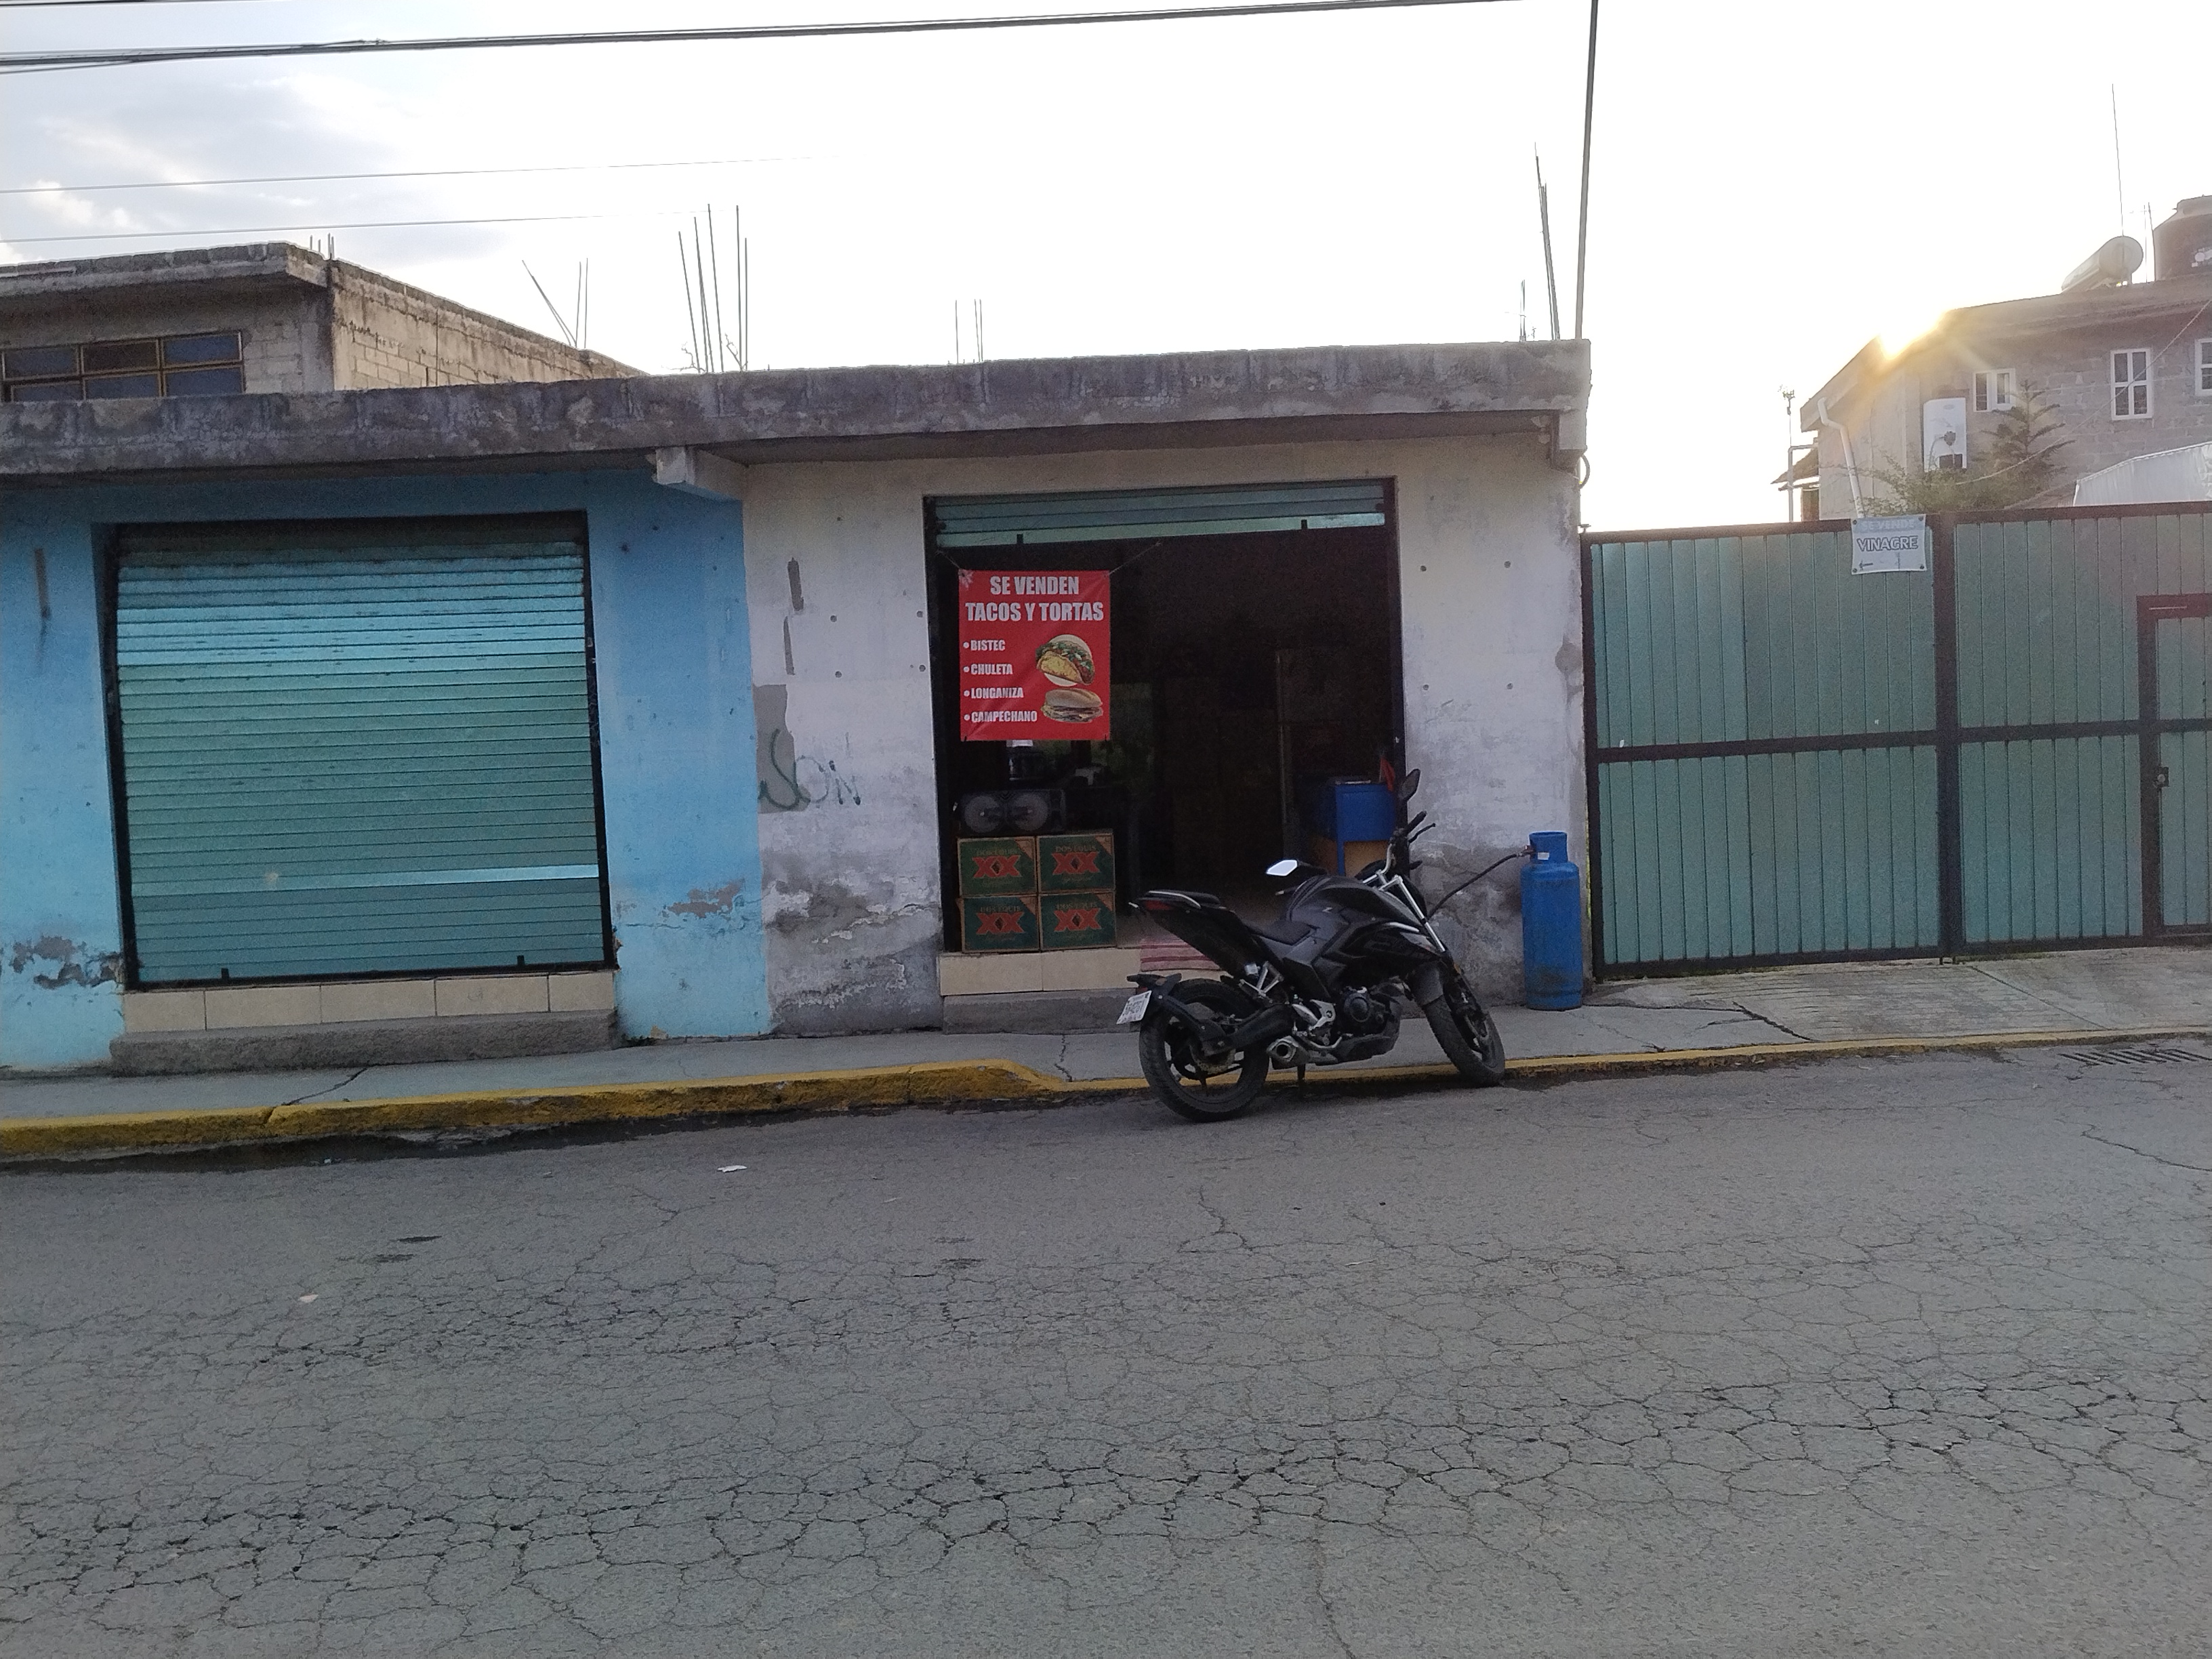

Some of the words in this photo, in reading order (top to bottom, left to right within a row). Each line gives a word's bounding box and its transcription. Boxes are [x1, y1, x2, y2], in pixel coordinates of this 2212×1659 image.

[1856, 535, 1919, 552] VINAGRE
[990, 576, 1010, 594] SE
[1014, 576, 1079, 594] VENDEN
[965, 602, 1021, 621] TACOS
[1025, 602, 1036, 621] Y
[1039, 602, 1104, 621] TORTAS
[970, 640, 1006, 651] BISTEC
[970, 663, 1013, 675] CHULETA
[970, 687, 1024, 699] LONGANIZA
[971, 710, 1038, 722] CAMPECHANO
